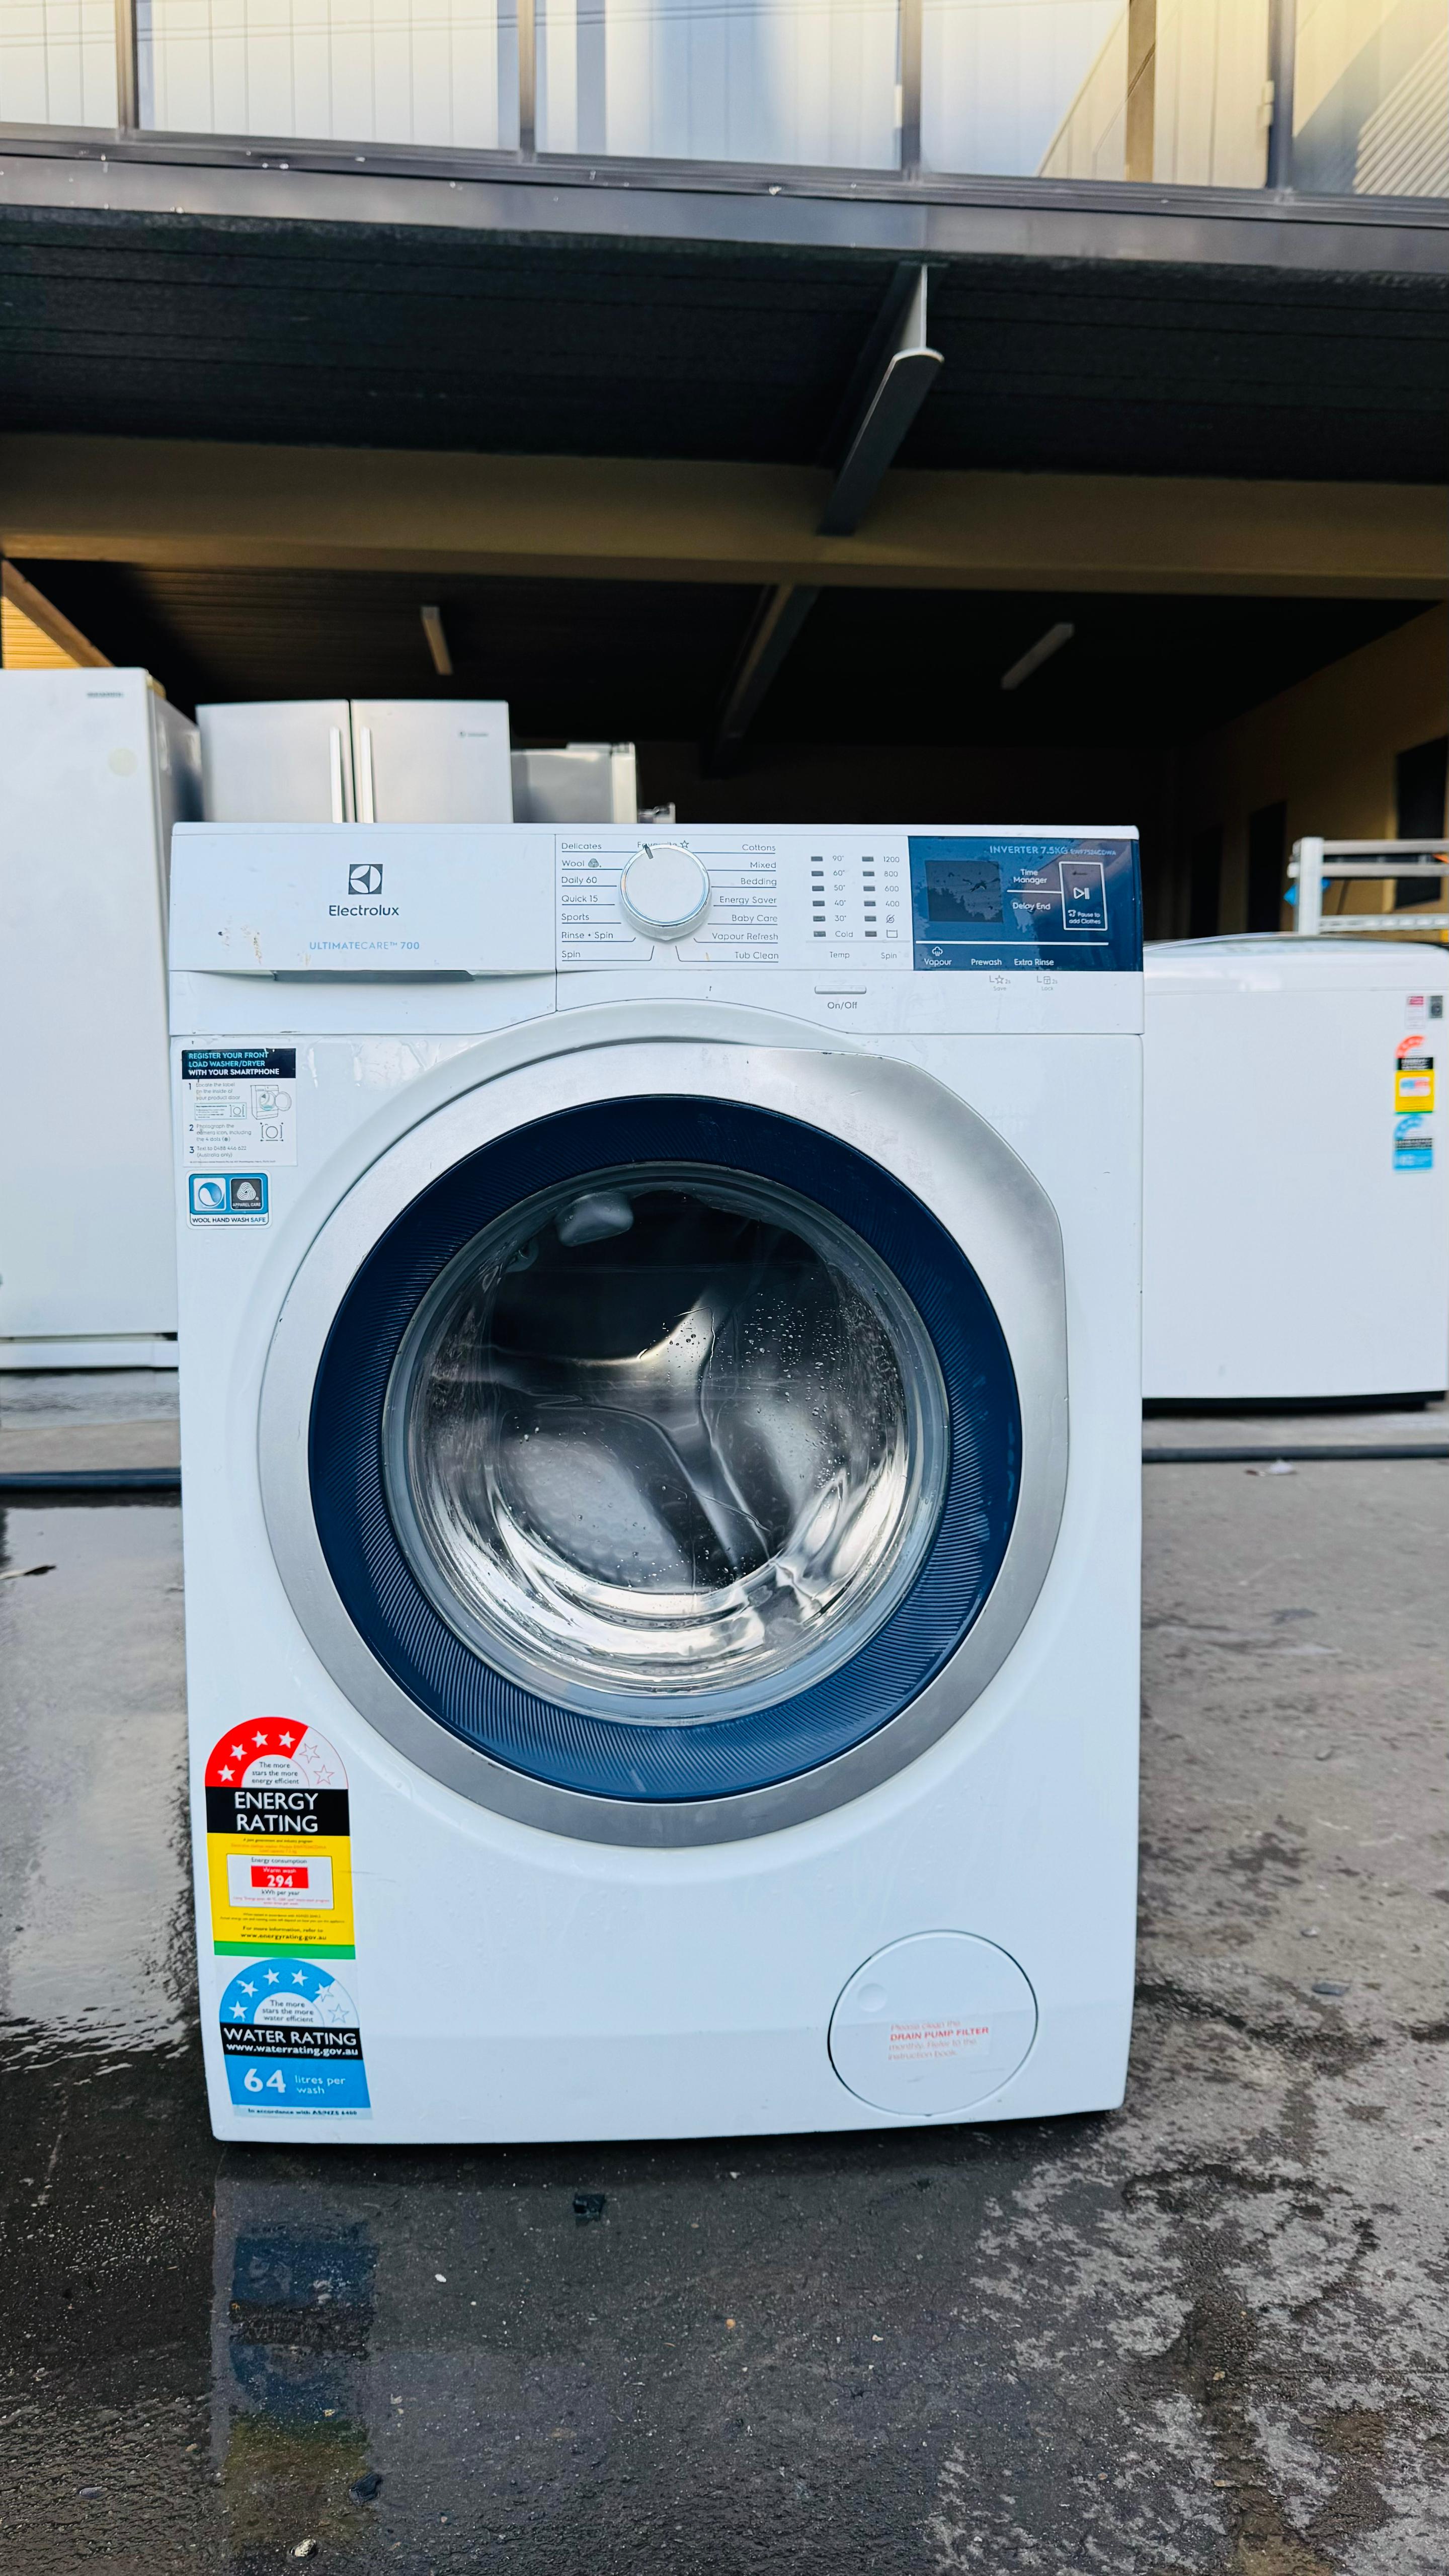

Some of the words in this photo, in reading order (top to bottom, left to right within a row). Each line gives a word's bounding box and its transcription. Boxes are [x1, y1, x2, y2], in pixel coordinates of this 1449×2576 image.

[1040, 846, 1068, 854] 7.5KG
[562, 876, 584, 885] Daily
[741, 878, 777, 886] Bedding
[720, 897, 750, 905] Energy
[329, 905, 399, 916] Electrolux
[1013, 903, 1034, 911] Delay
[562, 914, 589, 922] Sports
[732, 915, 754, 923] Baby
[595, 932, 613, 940] Spin
[712, 933, 744, 941] Vapour
[235, 1792, 318, 1810] ENERGY
[236, 1814, 318, 1833] RATING
[267, 1875, 293, 1887] 294
[224, 2028, 286, 2044] WATER
[291, 2031, 356, 2046] RATING
[890, 2033, 921, 2041] DRAIN
[925, 2030, 953, 2039] PUMP
[956, 2027, 989, 2036] FILTER
[226, 2044, 358, 2057] www.waterrating.gov.au
[244, 2068, 286, 2093] 64
[295, 2075, 323, 2084] litres
[327, 2077, 345, 2086] per
[297, 2086, 325, 2094] wash
